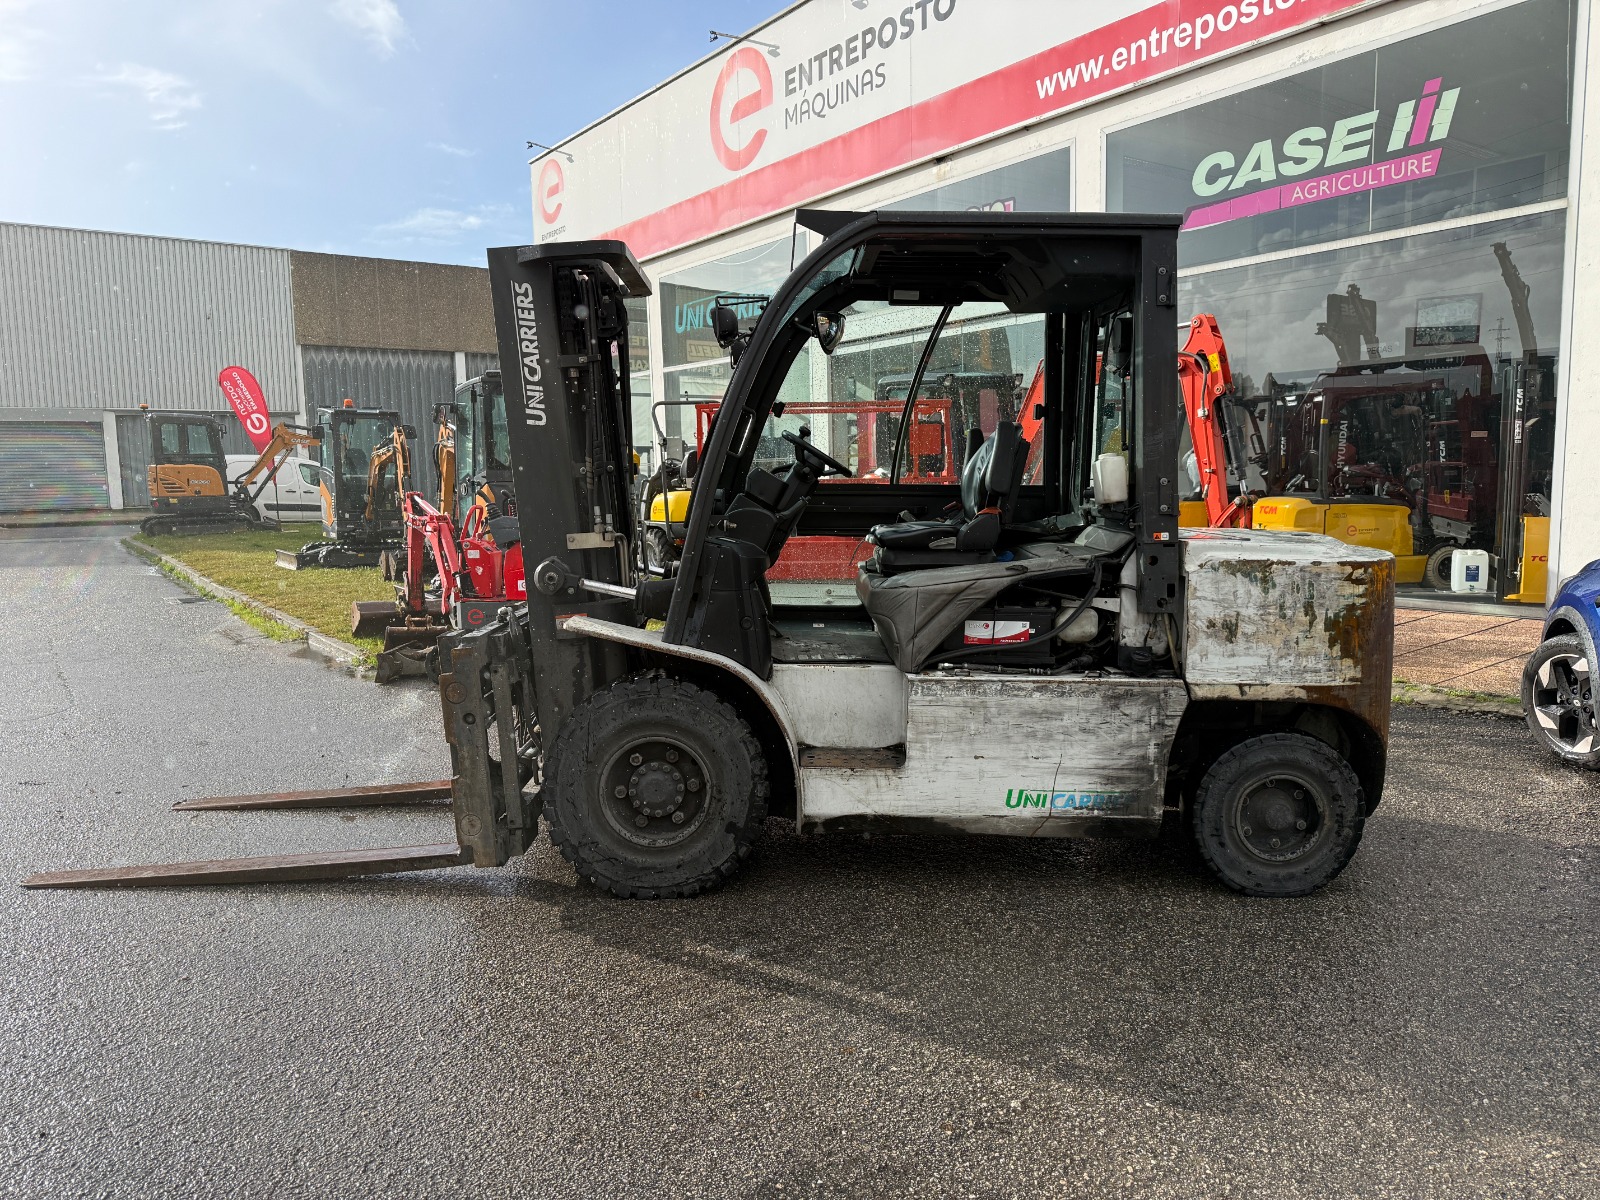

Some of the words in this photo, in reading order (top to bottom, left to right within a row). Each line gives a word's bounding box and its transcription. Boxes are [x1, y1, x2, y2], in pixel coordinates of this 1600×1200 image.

[784, 0, 956, 97] ENTREPOSTO
[784, 62, 887, 130] MÁQUINAS
[1191, 110, 1380, 197] CASE
[1290, 154, 1433, 203] AGRICULTURE
[514, 281, 547, 426] UNICARRIERS
[1515, 388, 1524, 412] TCM
[1336, 420, 1349, 469] HYUNDAI
[1438, 440, 1446, 463] TCM
[1260, 505, 1278, 515] TCM
